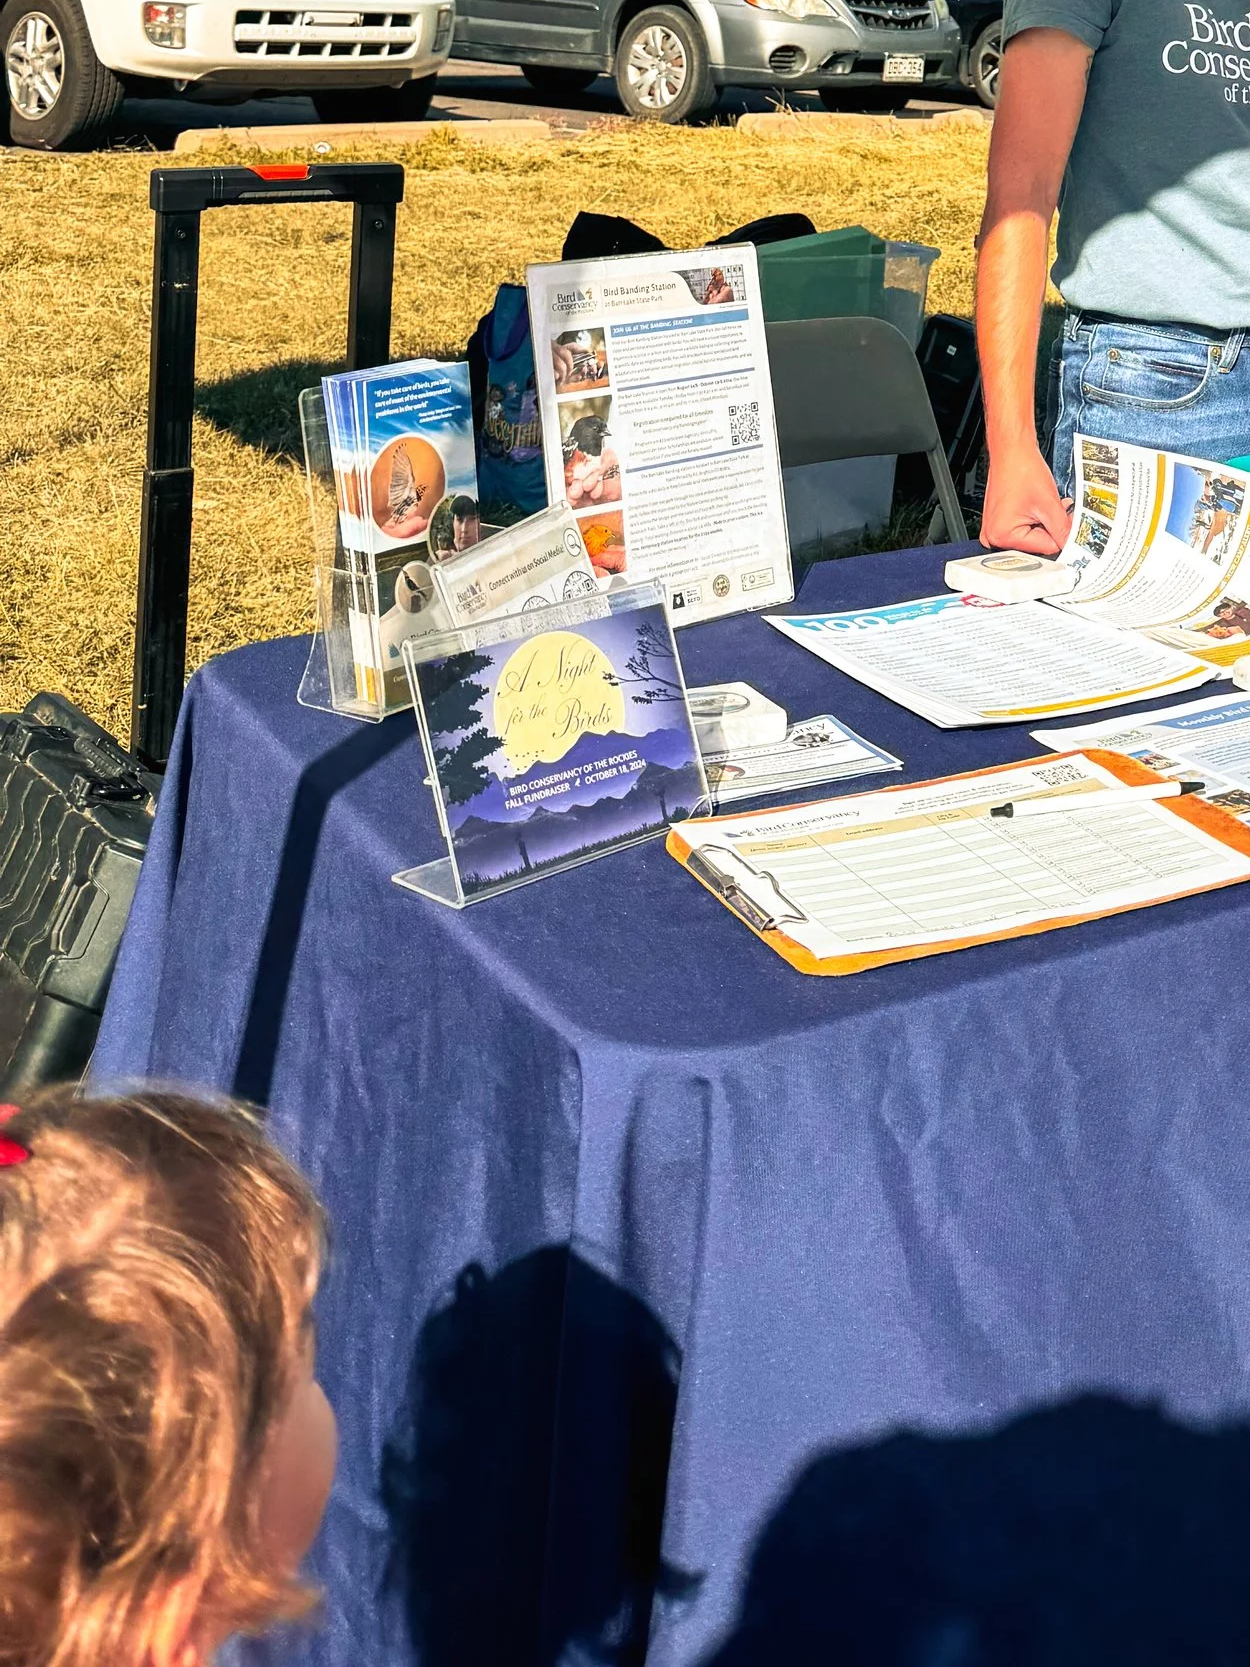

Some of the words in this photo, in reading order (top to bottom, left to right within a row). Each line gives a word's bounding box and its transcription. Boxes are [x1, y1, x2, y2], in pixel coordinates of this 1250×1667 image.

[1224, 83, 1239, 104] of
[557, 291, 576, 304] Bird
[603, 286, 619, 297] Bird
[620, 284, 650, 295] Banding
[651, 282, 677, 292] Station
[636, 297, 650, 305] State
[651, 295, 663, 303] Park
[552, 300, 599, 313] Conservancy
[612, 326, 624, 334] JOIN
[625, 325, 632, 333] US
[639, 323, 650, 331] THE
[488, 574, 511, 591] Connect
[510, 567, 522, 580] with
[527, 562, 535, 571] on
[533, 553, 548, 568] Social
[804, 615, 888, 633] 100
[497, 649, 539, 699] A
[537, 638, 597, 695] Night
[504, 704, 525, 735] for
[528, 693, 549, 720] the
[552, 697, 614, 740] Birds
[1177, 712, 1225, 727] Monthly
[1222, 706, 1250, 717] Bird
[509, 783, 528, 797] BIRD
[528, 767, 583, 791] CONSERVANCY
[583, 764, 594, 774] OF
[594, 760, 609, 771] THE
[608, 749, 638, 766] ROCKIES
[504, 798, 524, 811] FALL
[524, 782, 571, 805] FUNDRAISER
[584, 767, 619, 785] OCTOBER
[618, 765, 630, 775] 18,
[629, 758, 647, 771] 2024
